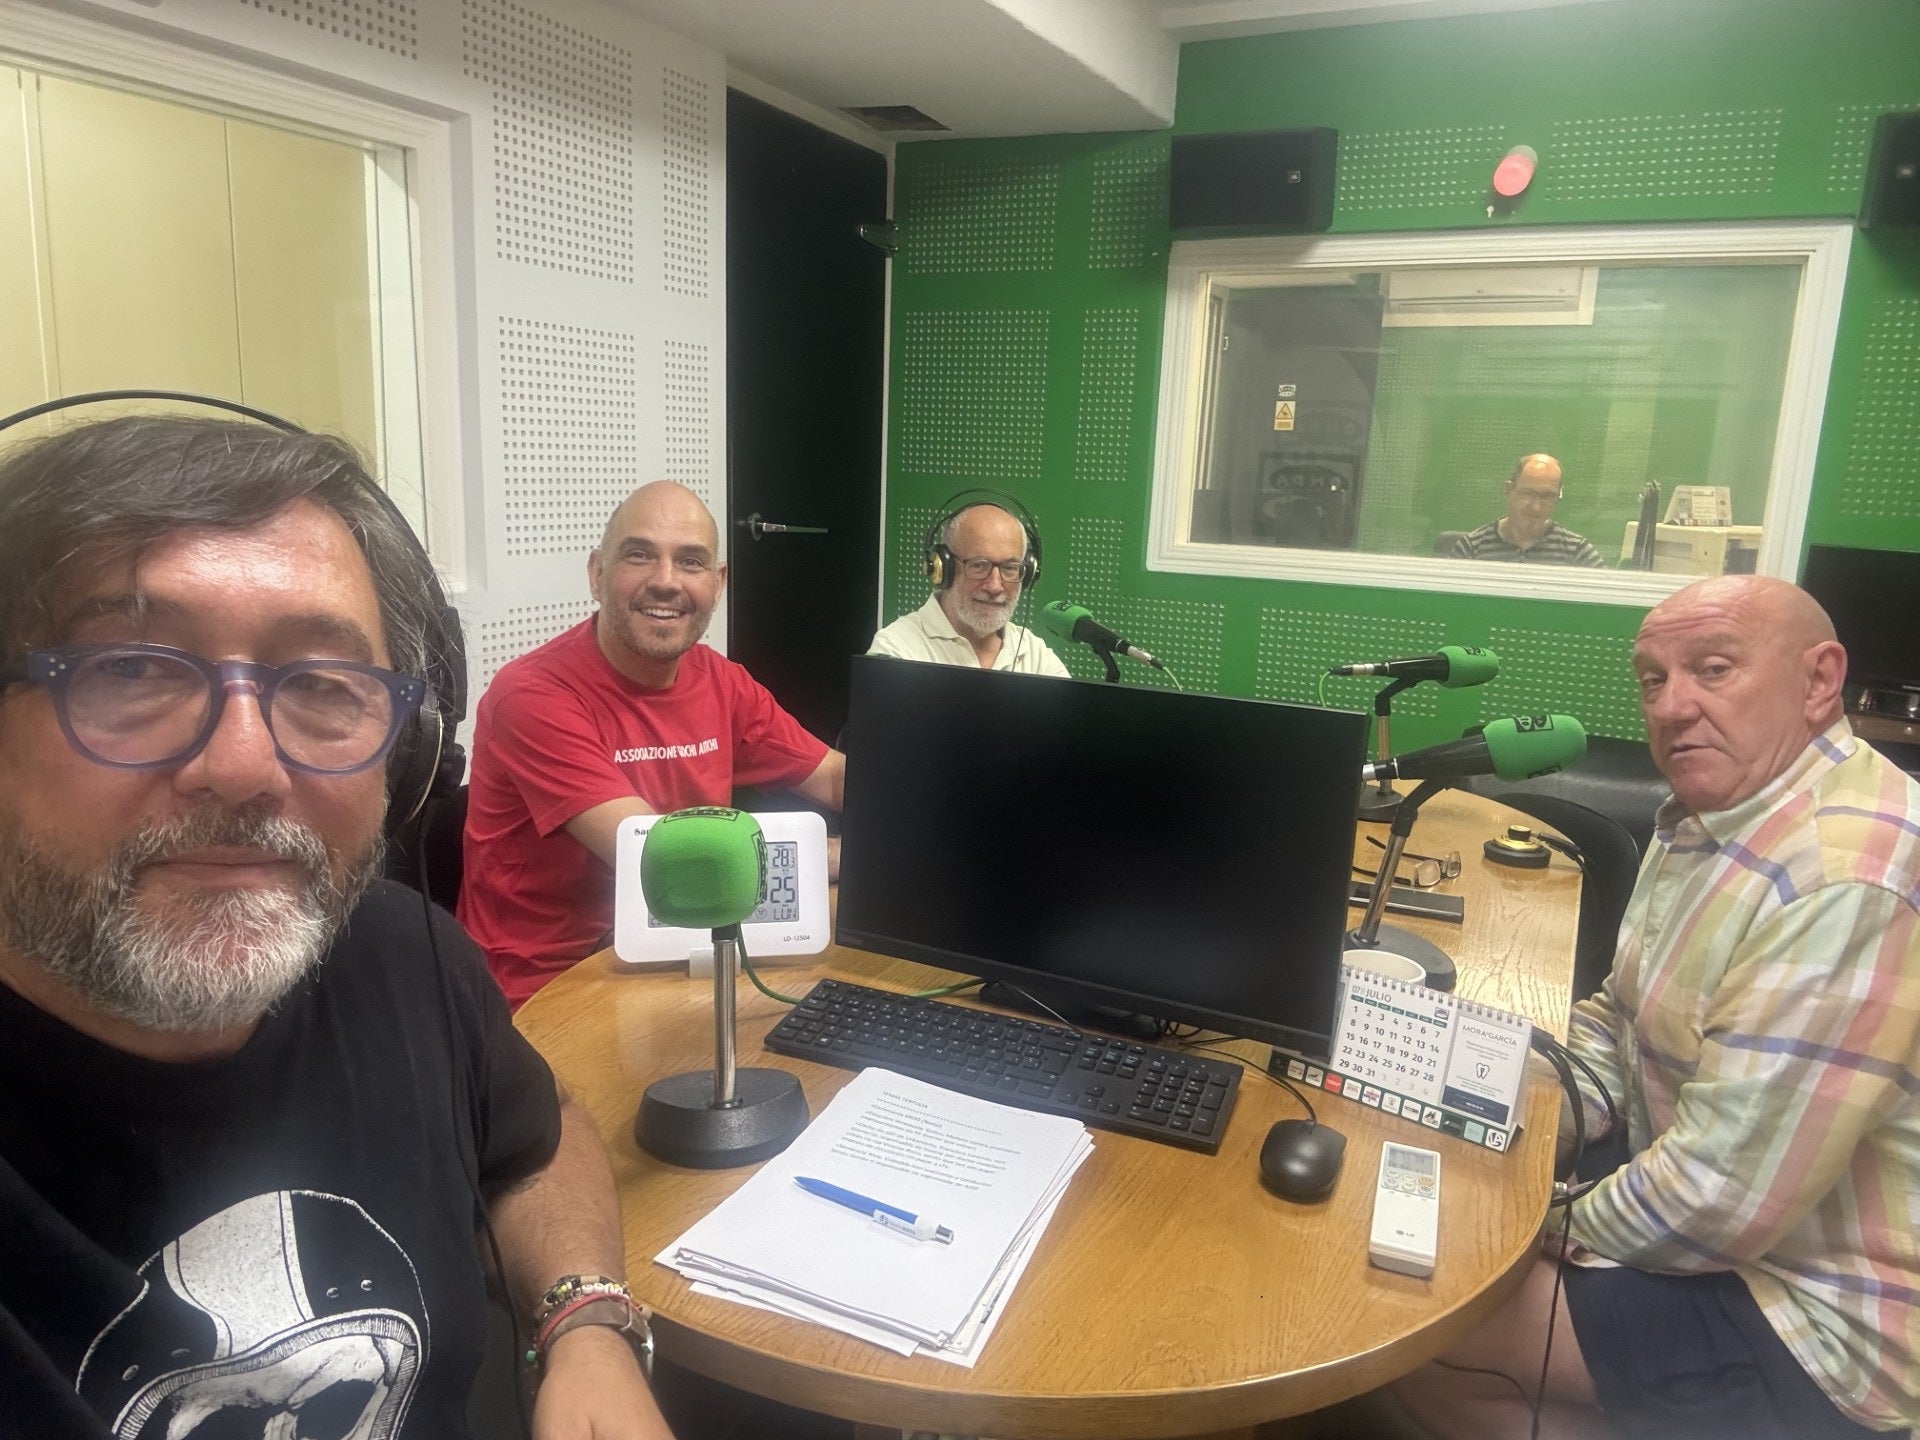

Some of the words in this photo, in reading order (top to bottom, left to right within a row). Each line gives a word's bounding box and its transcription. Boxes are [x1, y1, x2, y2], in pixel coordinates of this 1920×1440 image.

[772, 848, 789, 867] 28
[770, 876, 796, 904] 25
[783, 934, 811, 942] LD-12504
[1366, 990, 1391, 1002] JULIO
[1360, 1037, 1368, 1045] 16
[1373, 1041, 1381, 1049] 17
[1386, 1046, 1395, 1054] 18
[1427, 1059, 1436, 1067] 21
[1403, 1036, 1411, 1044] 12
[1417, 1040, 1425, 1048] 13
[1430, 1045, 1439, 1053] 14
[1339, 1059, 1349, 1067] 29
[1352, 1064, 1362, 1072] 30
[1366, 1069, 1375, 1077] 31
[1343, 1046, 1352, 1054] 22
[1356, 1050, 1365, 1058] 23
[1369, 1055, 1378, 1063] 24
[1382, 1059, 1392, 1067] 25
[1396, 1064, 1406, 1072] 26
[1410, 1068, 1419, 1076] 27
[1423, 1073, 1433, 1081] 28
